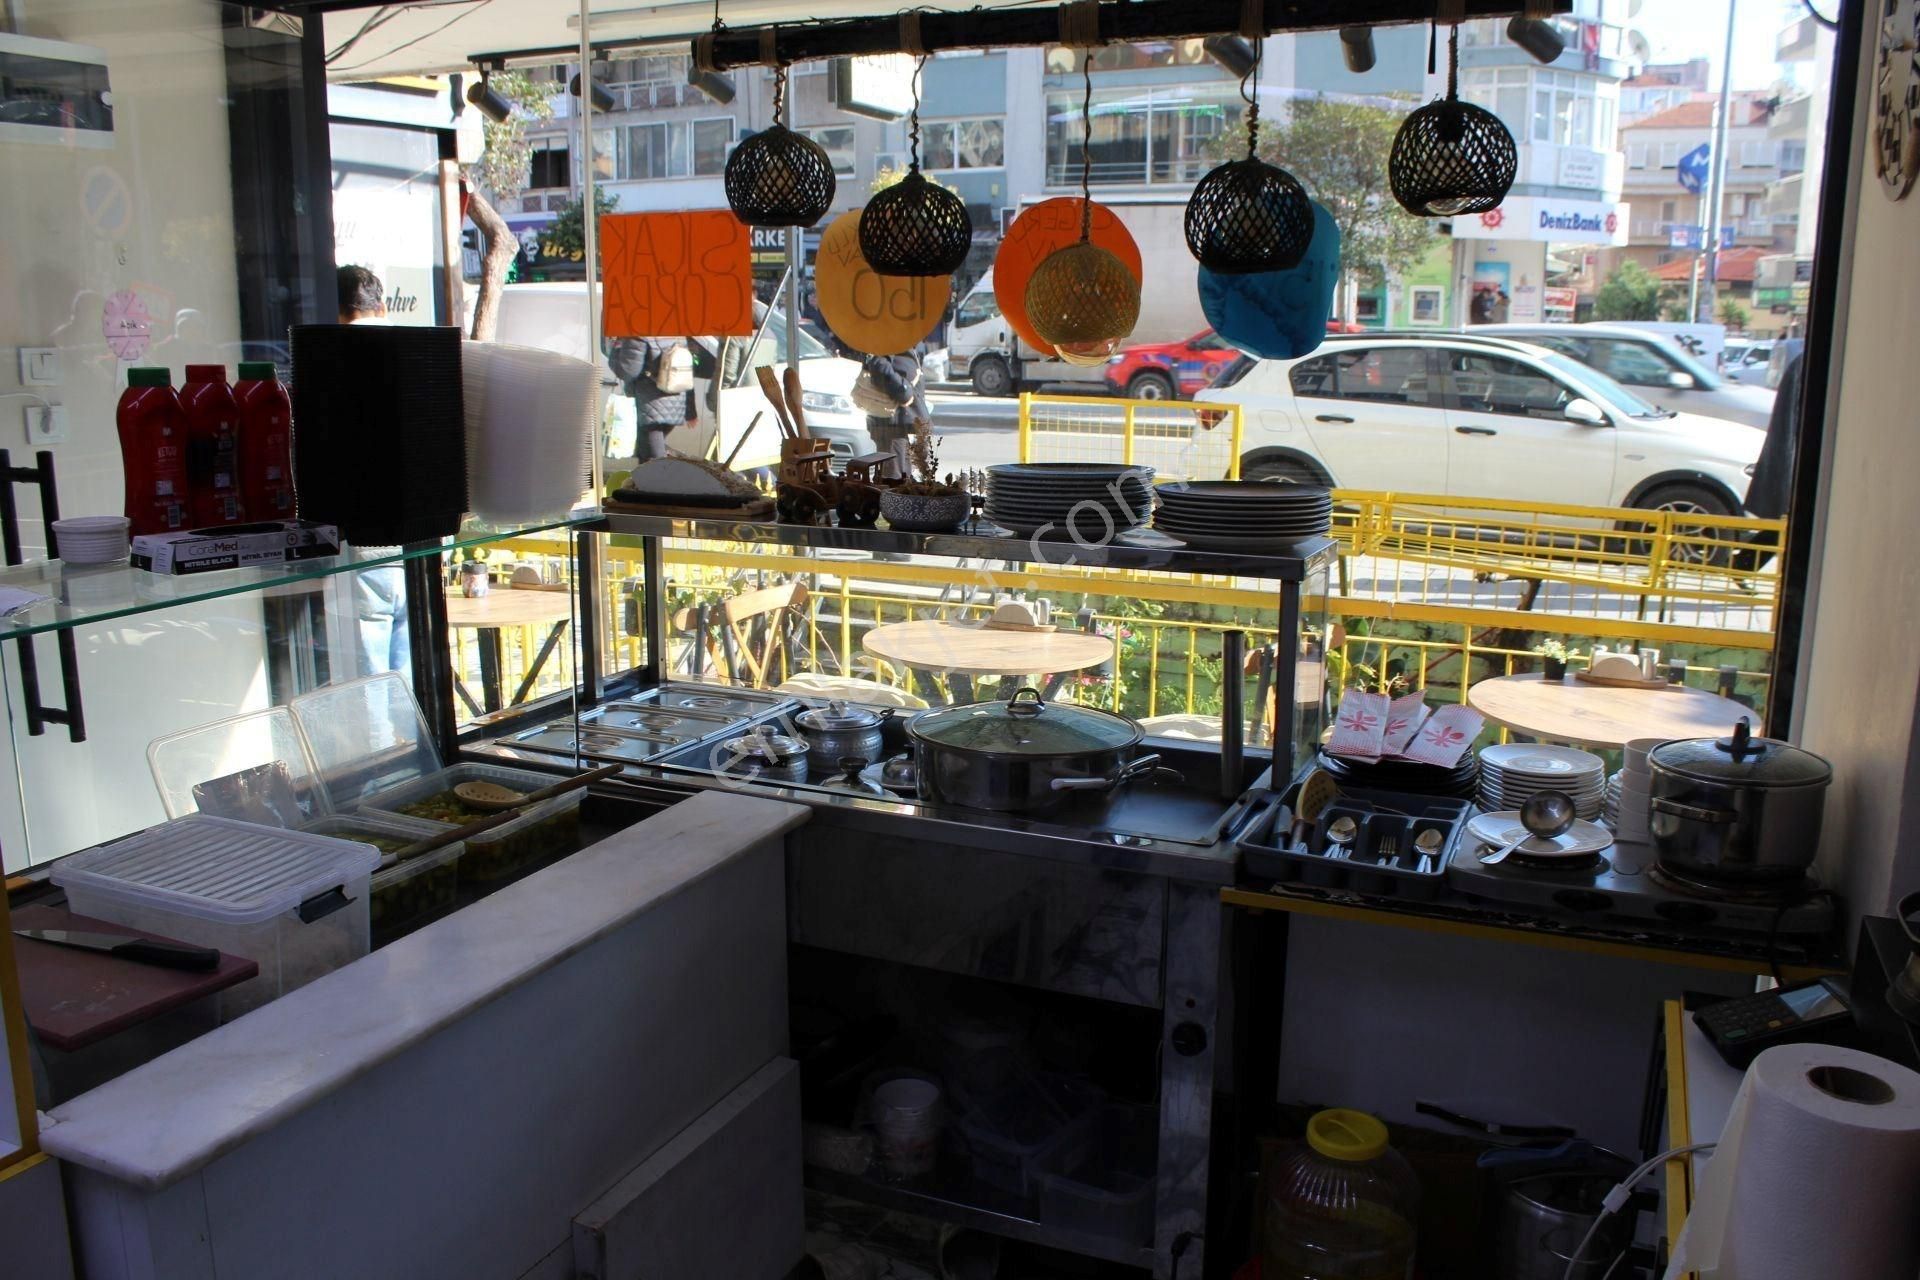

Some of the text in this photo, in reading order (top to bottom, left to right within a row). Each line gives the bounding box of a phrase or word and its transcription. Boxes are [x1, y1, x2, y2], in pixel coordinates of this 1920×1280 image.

[1539, 210, 1601, 232] DenizBank
[385, 286, 418, 313] ahve
[293, 548, 301, 558] L
